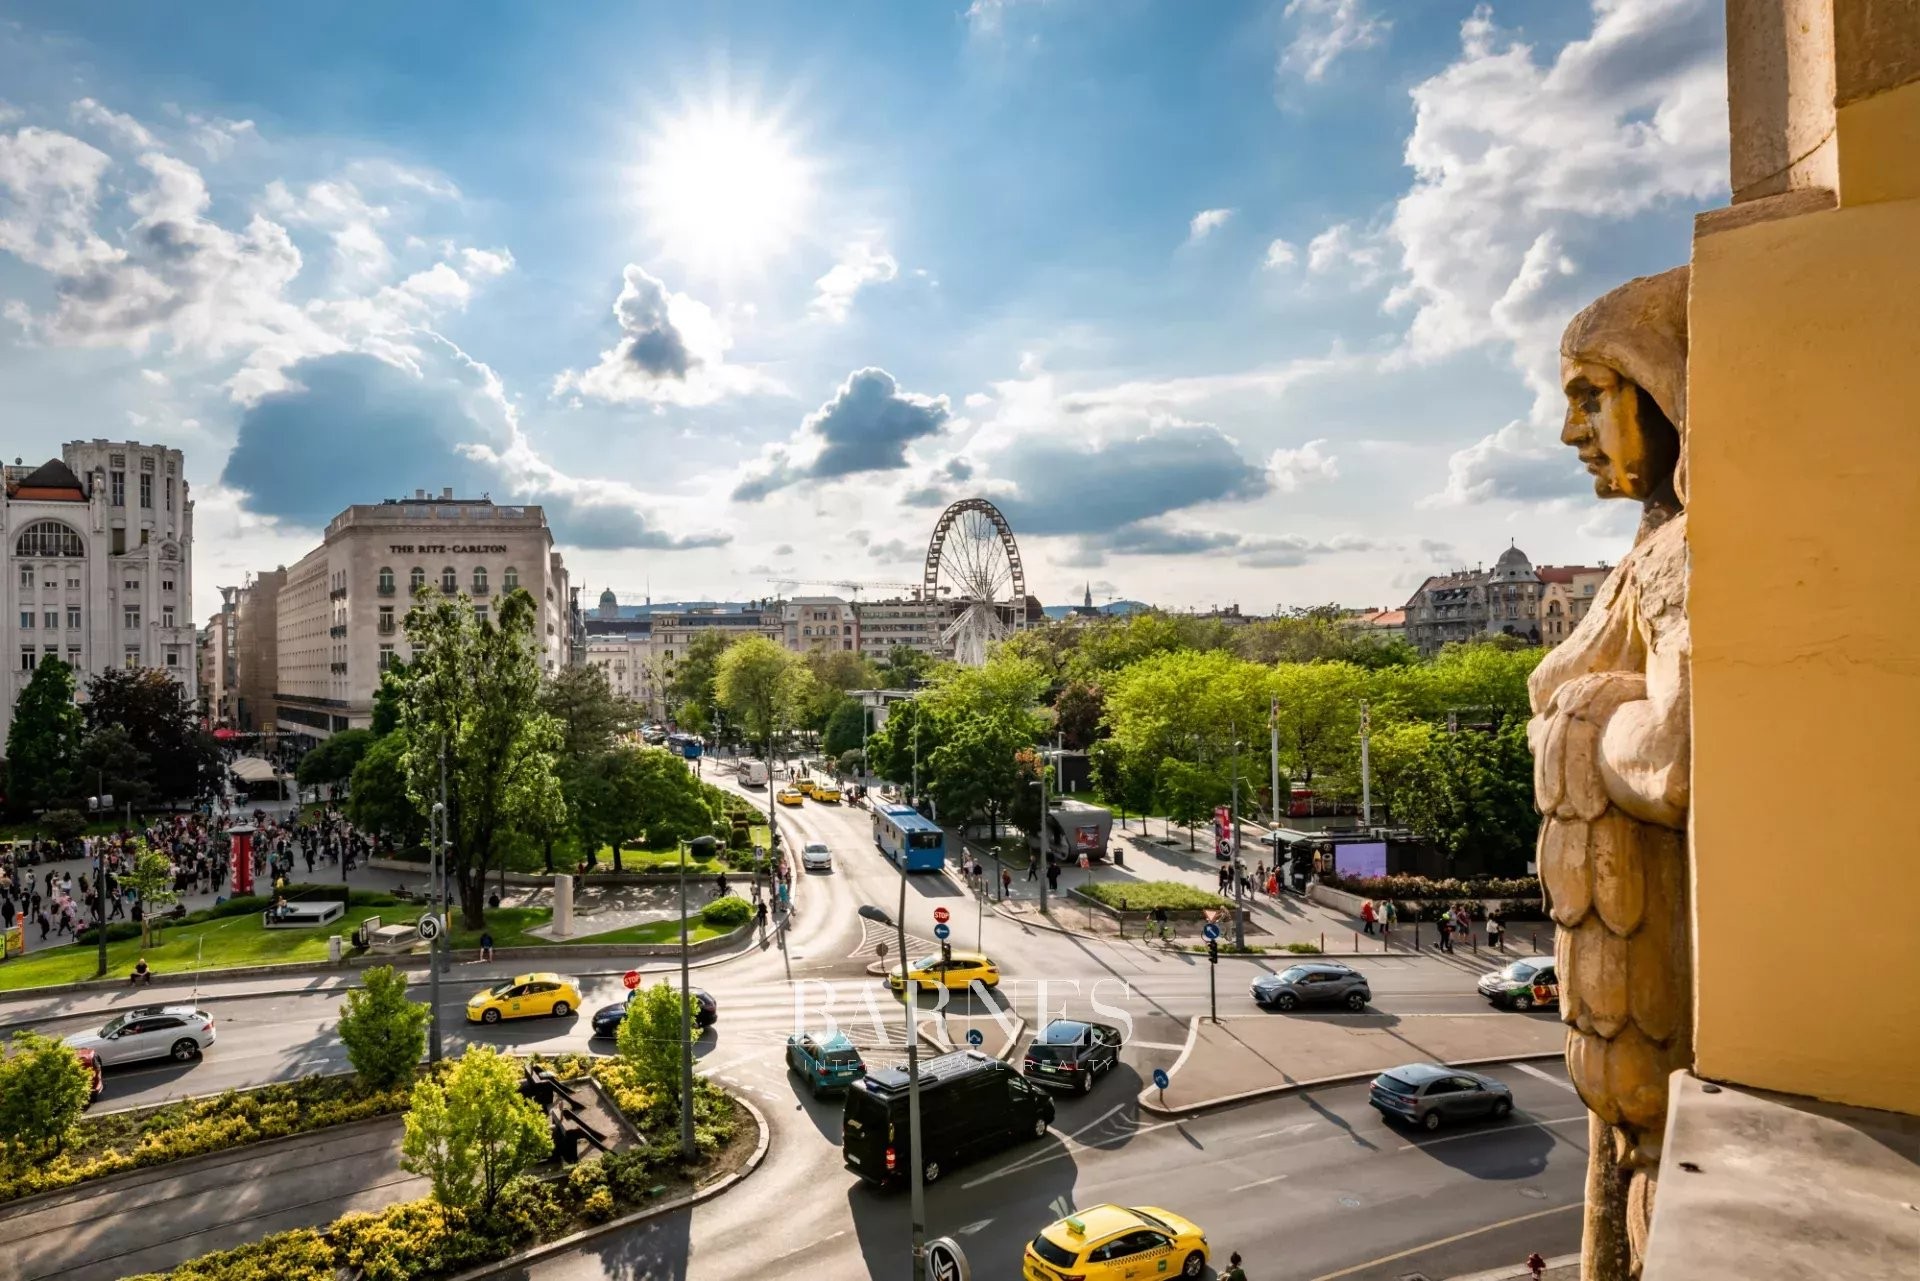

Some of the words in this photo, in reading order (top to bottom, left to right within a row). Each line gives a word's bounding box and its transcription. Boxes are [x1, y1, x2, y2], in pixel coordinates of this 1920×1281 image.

[389, 545, 415, 553] THE
[934, 911, 949, 919] STOP
[422, 923, 434, 936] M
[624, 974, 640, 985] STOP
[934, 1250, 954, 1281] M
